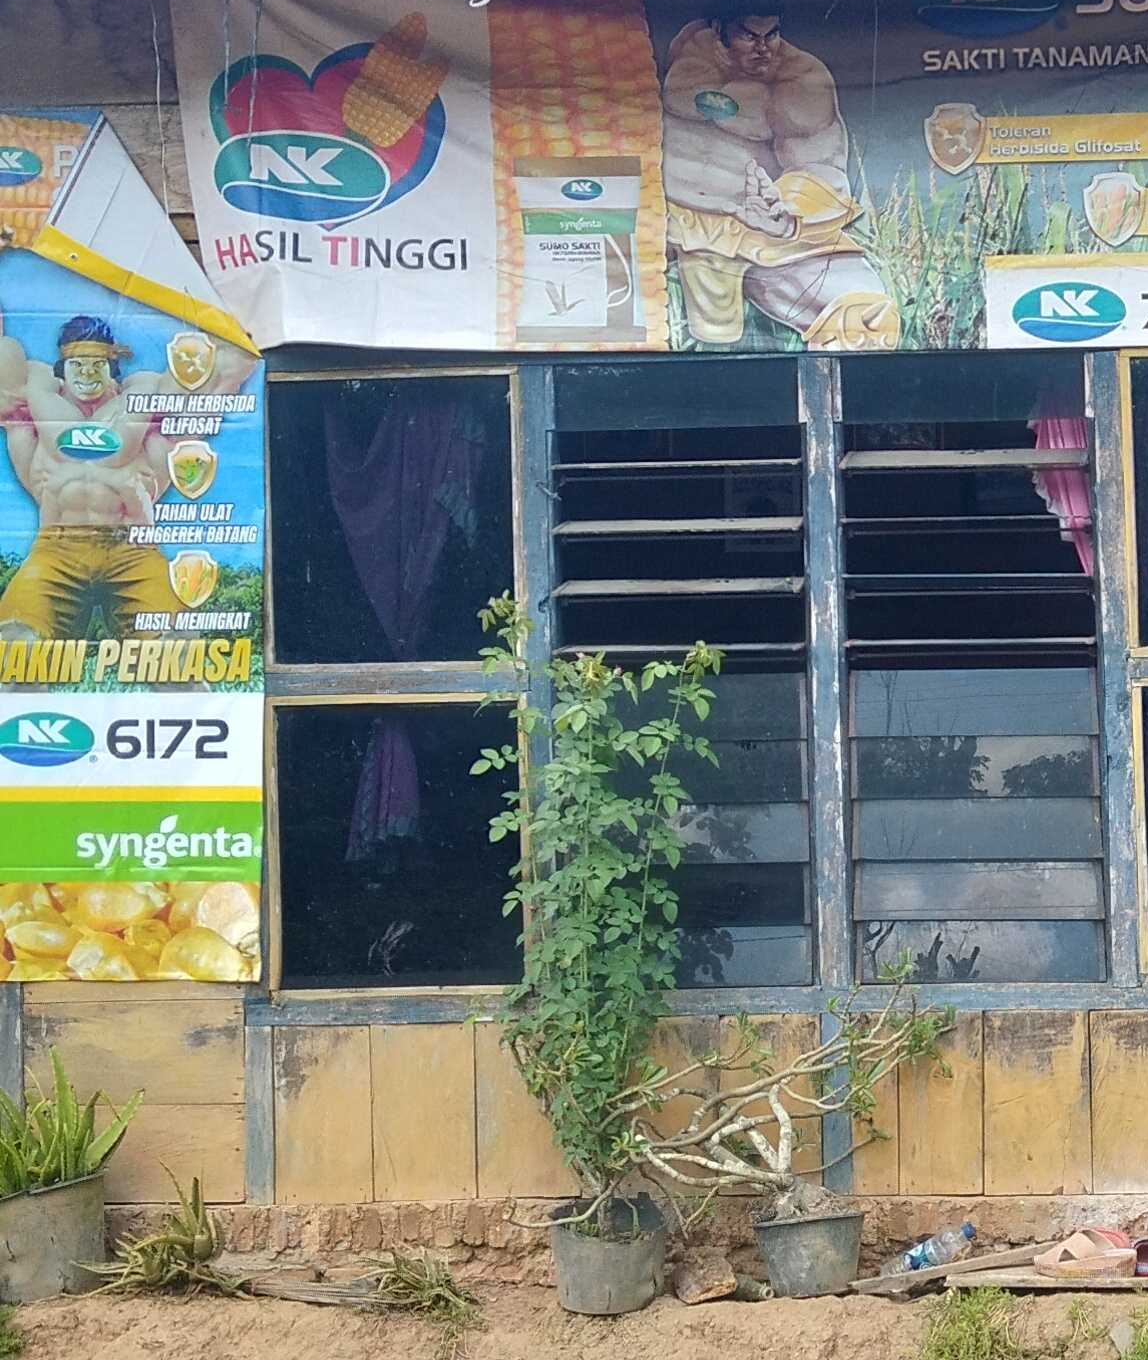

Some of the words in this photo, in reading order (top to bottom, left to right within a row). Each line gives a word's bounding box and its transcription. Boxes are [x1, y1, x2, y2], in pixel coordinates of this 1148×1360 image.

[923, 49, 1005, 72] SAKTI
[991, 126, 1051, 139] Toleran
[990, 142, 1070, 156] Herbisida
[1074, 139, 1143, 154] Glifosat
[250, 144, 344, 186] NK
[215, 230, 312, 270] HASIL
[322, 236, 468, 270] TINGGI
[1041, 290, 1100, 317] NK
[127, 394, 185, 413] TOLERAN
[186, 394, 256, 413] HERBISIDA
[160, 417, 223, 435] GLIFOSAT
[71, 429, 107, 446] NK
[154, 504, 198, 521] TAHAN
[200, 504, 234, 521] ULAT
[128, 525, 203, 544] PENGGEREK
[205, 525, 257, 544] BATANG
[135, 613, 171, 630] HASIL
[175, 612, 251, 630] MENINGKAT
[94, 638, 251, 683] PERKASA
[18, 719, 71, 744] NK
[106, 719, 230, 759] 6172
[76, 826, 254, 870] syngenta
